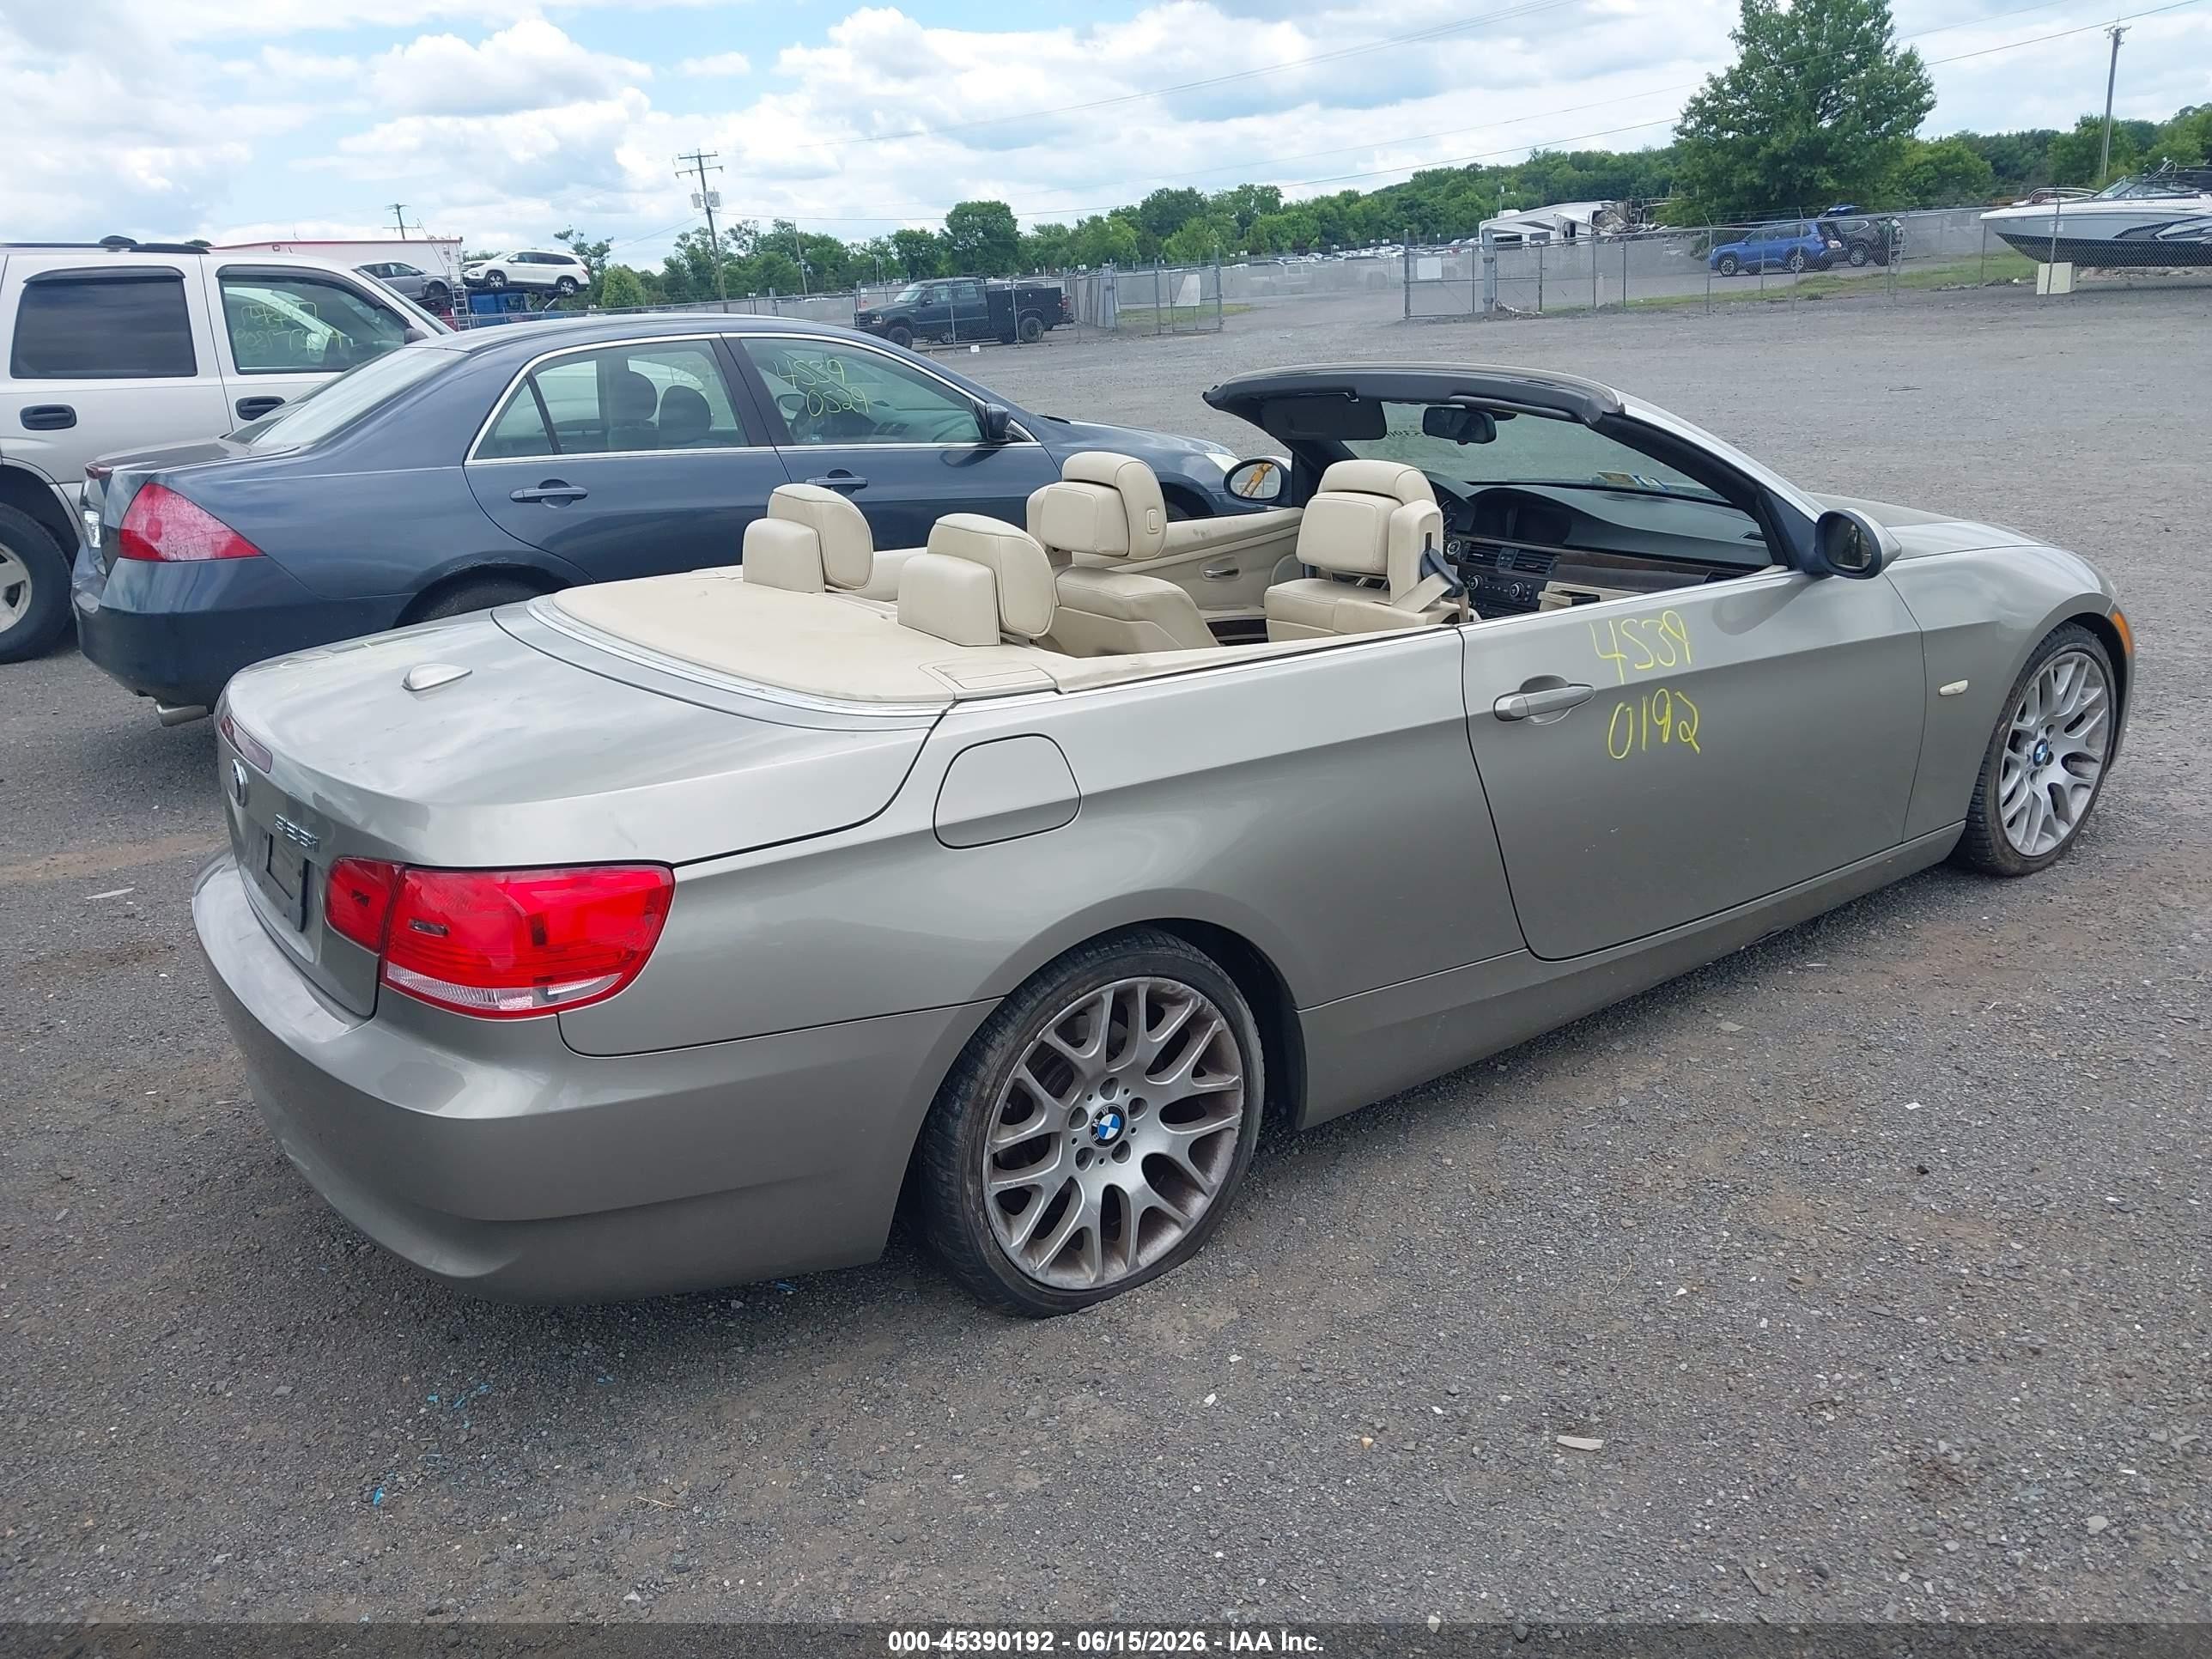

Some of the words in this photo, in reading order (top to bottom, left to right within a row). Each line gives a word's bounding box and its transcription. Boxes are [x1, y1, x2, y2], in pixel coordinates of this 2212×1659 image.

[773, 359, 845, 389] 4539
[807, 386, 869, 416] 0529
[1589, 611, 1692, 685] 4539
[1608, 689, 1701, 759] 0192
[1091, 1107, 1109, 1141] BMW
